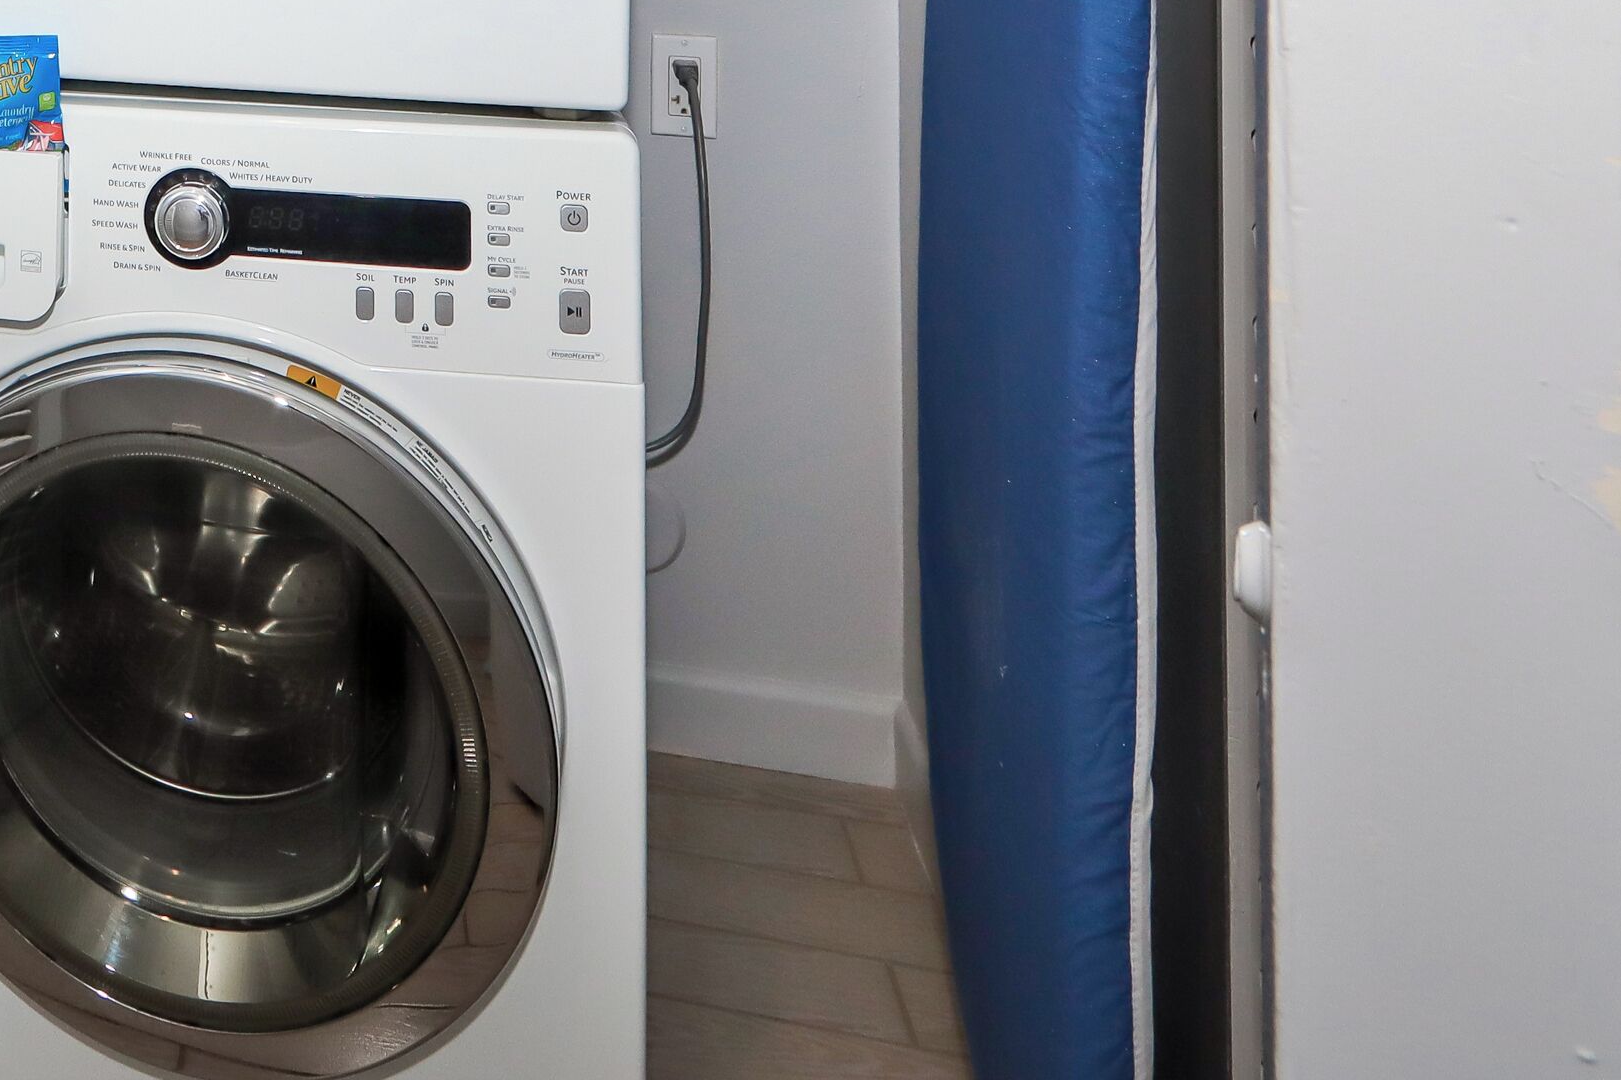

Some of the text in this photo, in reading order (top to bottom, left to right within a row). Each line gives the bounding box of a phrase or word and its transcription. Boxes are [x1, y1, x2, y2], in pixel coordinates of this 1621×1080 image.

[139, 151, 193, 161] WRINKLE FREE
[112, 162, 162, 173] ACTIVE WEAR
[200, 157, 231, 167] COLORS
[237, 159, 270, 169] NORMAL
[229, 172, 259, 181] WHITES
[266, 174, 291, 183] HEAVY
[292, 175, 313, 184] DUTY
[108, 179, 147, 189] DELICATES
[487, 193, 506, 201] DELAY
[556, 190, 592, 201] POWER
[93, 198, 139, 209] HAND WASH
[91, 219, 139, 230] SPEED WASH
[99, 241, 121, 251] RINSE
[128, 244, 146, 253] SPIN
[498, 256, 516, 264] CYCLE
[113, 261, 137, 270] DRAIN
[144, 263, 161, 272] SPIN
[560, 266, 588, 277] START
[225, 269, 278, 281] BASKETCLEAN
[356, 272, 375, 282] SOIL
[393, 274, 417, 285] TEMP
[434, 277, 455, 287] SPIN
[563, 277, 585, 285] PAUSE
[487, 287, 509, 295] SIGNAL
